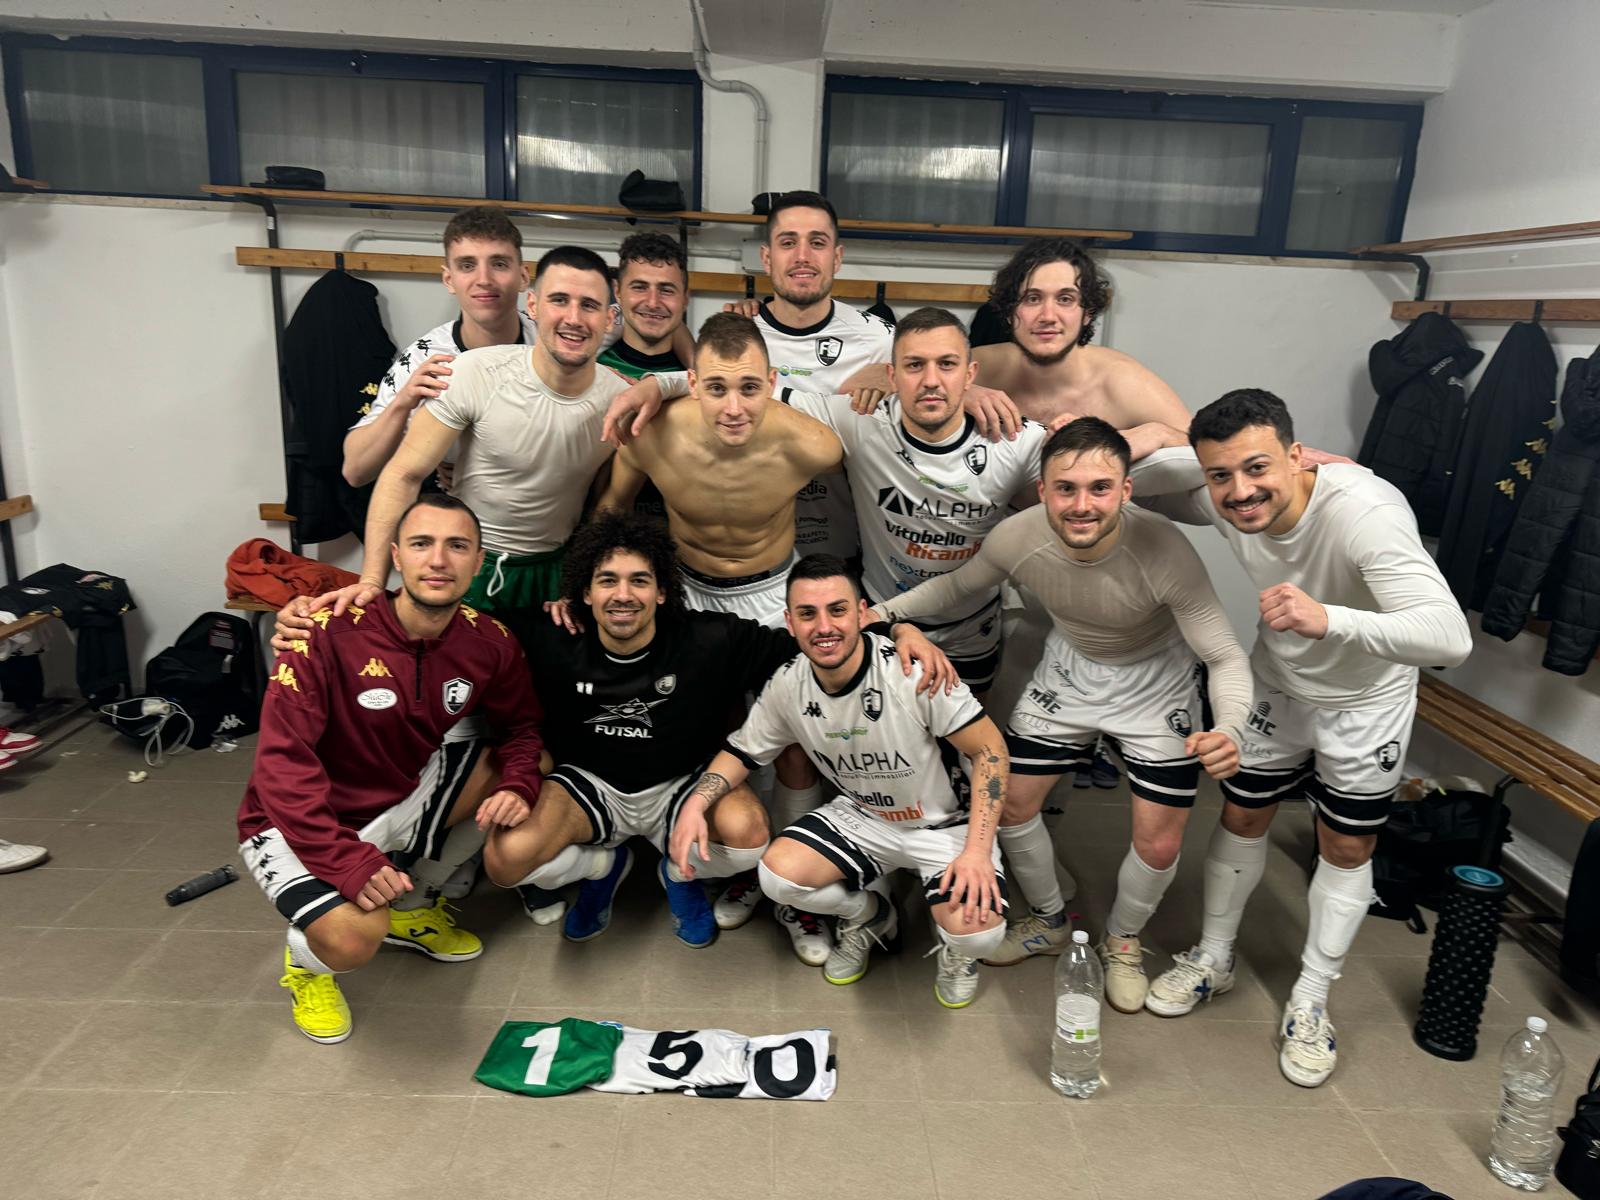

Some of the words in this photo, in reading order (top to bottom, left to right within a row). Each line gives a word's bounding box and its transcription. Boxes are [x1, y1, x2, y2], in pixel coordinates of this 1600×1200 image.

[915, 497, 998, 519] ALPHA
[906, 539, 983, 561] Ricamb
[594, 724, 653, 739] FUTSAL
[838, 750, 911, 772] ALPHA
[521, 1026, 562, 1086] 1
[648, 1030, 704, 1081] 5
[754, 1037, 817, 1099] 0
